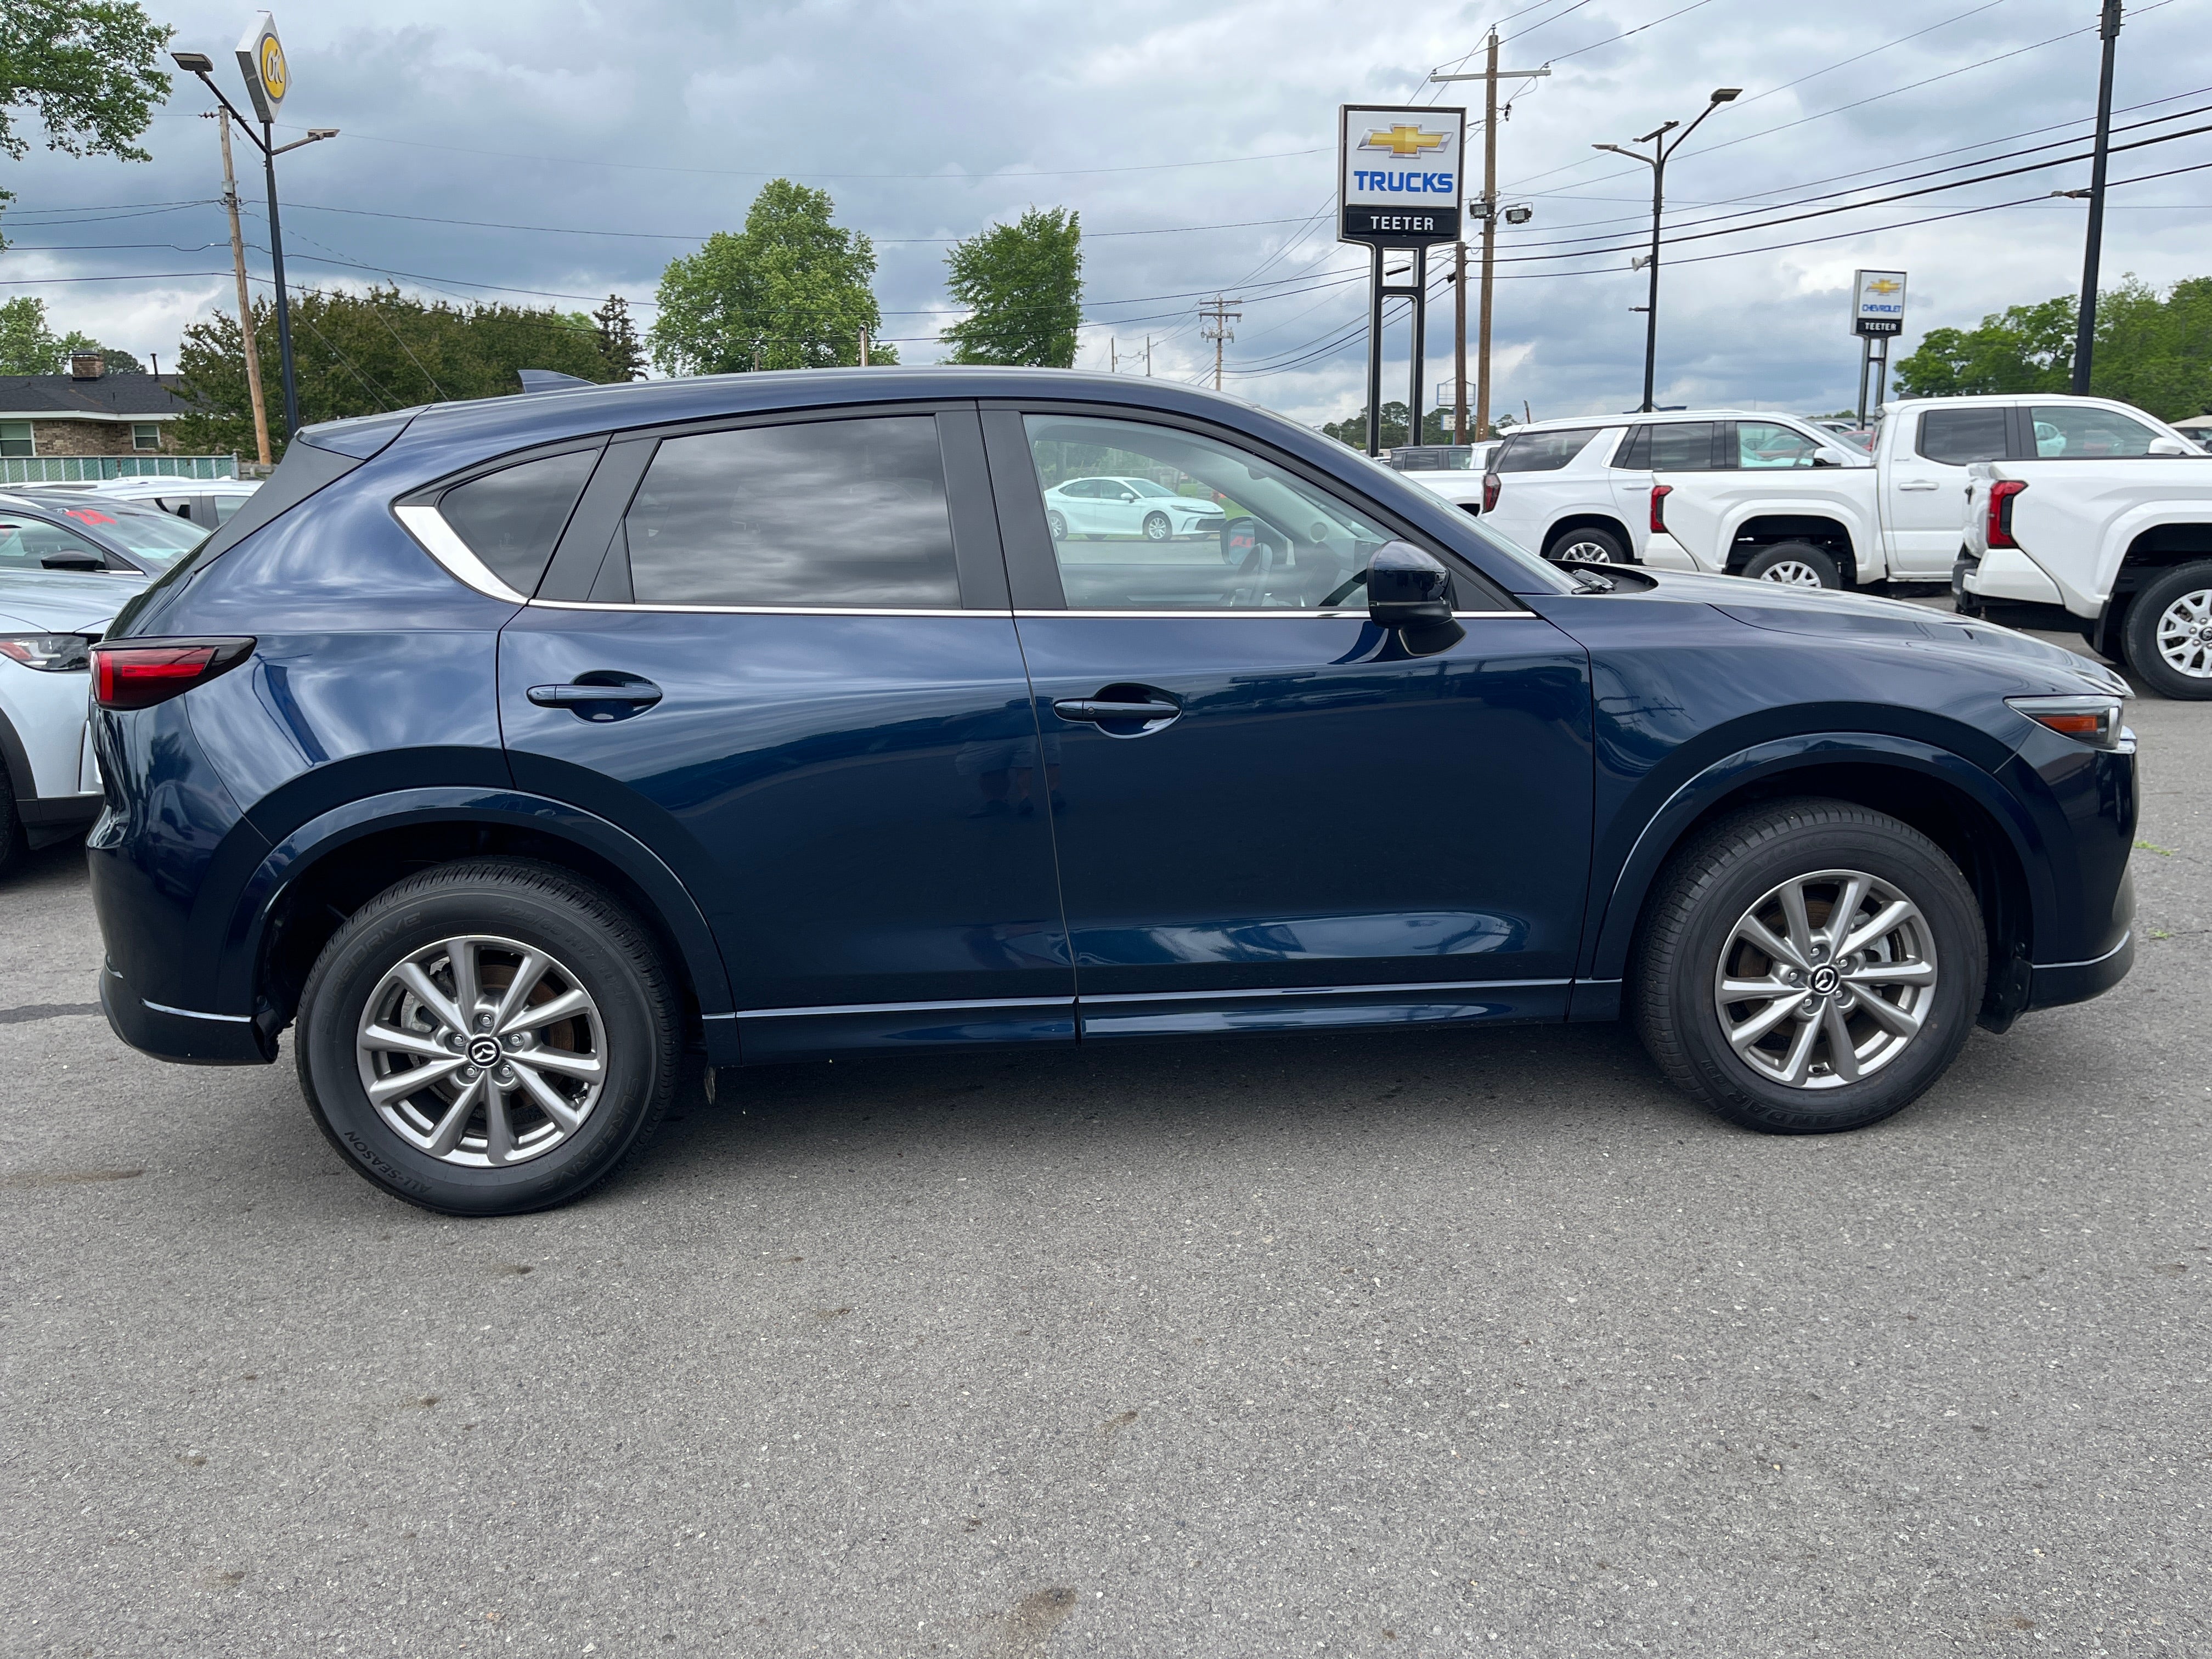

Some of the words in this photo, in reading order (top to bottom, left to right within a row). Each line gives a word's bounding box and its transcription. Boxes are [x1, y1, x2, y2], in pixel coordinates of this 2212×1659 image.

[266, 48, 284, 84] OK
[1354, 171, 1453, 193] TRUCKS
[1370, 216, 1434, 231] TEETER
[1862, 304, 1902, 313] CHEVROLET
[1865, 322, 1897, 331] TEETER
[538, 1075, 640, 1193] SUREDRIVE
[343, 1130, 433, 1194] ALL-SEASON
